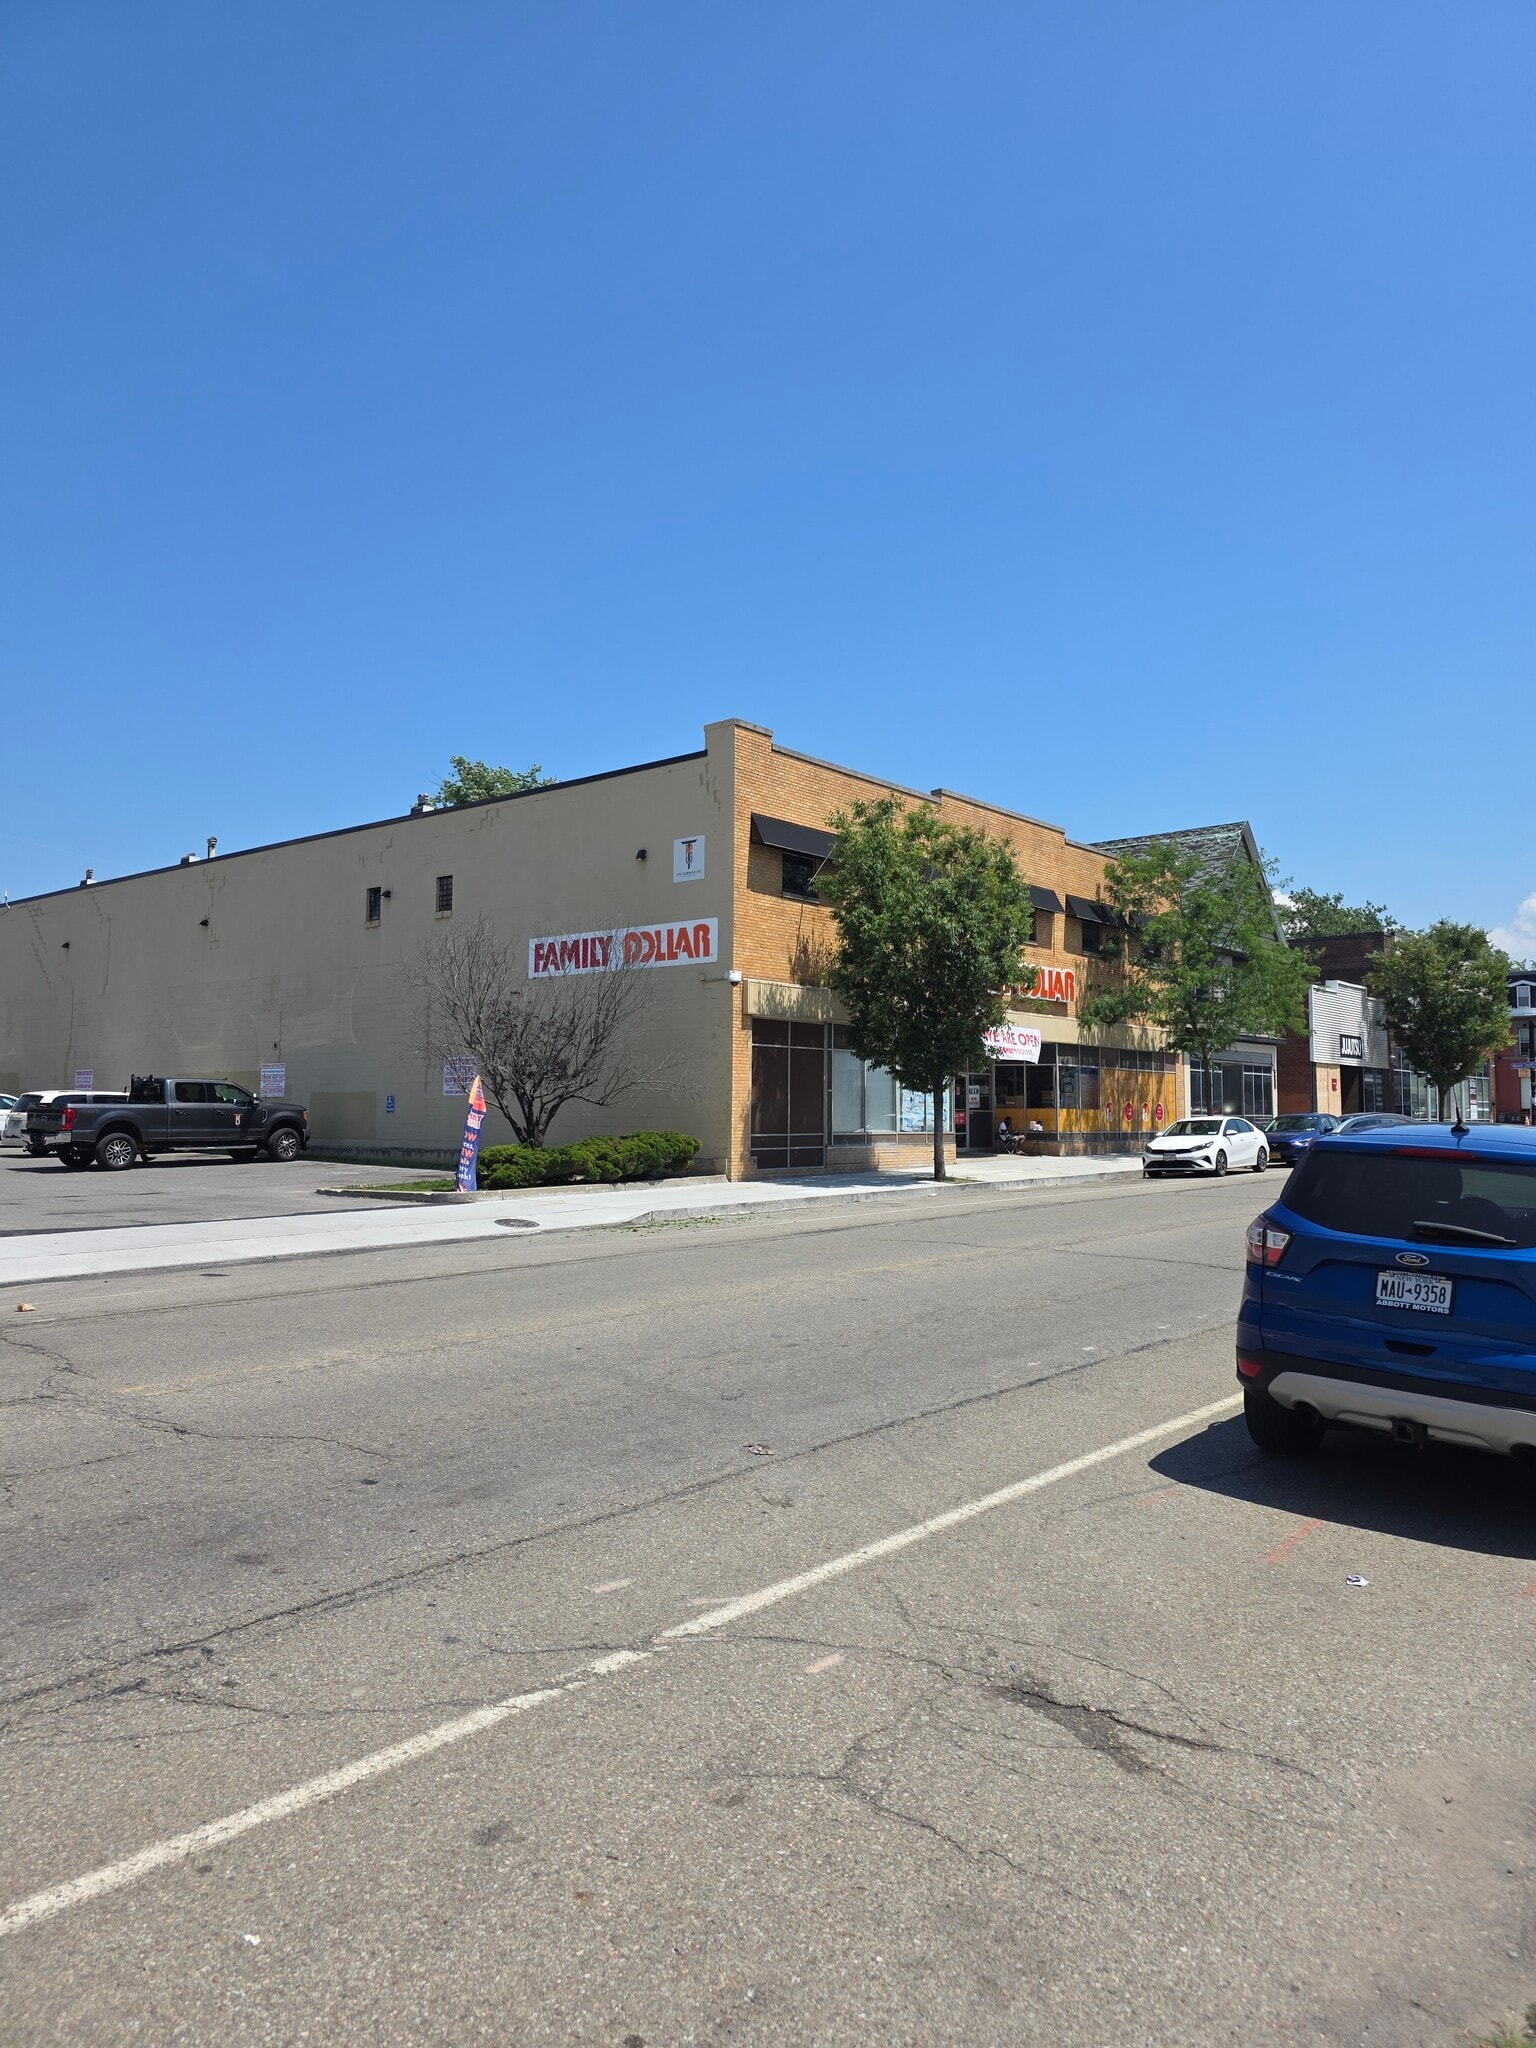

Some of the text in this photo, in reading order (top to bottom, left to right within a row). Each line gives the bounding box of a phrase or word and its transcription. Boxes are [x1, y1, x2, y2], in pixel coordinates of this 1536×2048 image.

[533, 923, 711, 973] FAMILY DOLLAR
[1018, 1033, 1040, 1048] OPEN
[1402, 1254, 1421, 1264] Ford
[1414, 1277, 1434, 1285] YORK
[1376, 1299, 1450, 1314] ABBOTT MOTORS
